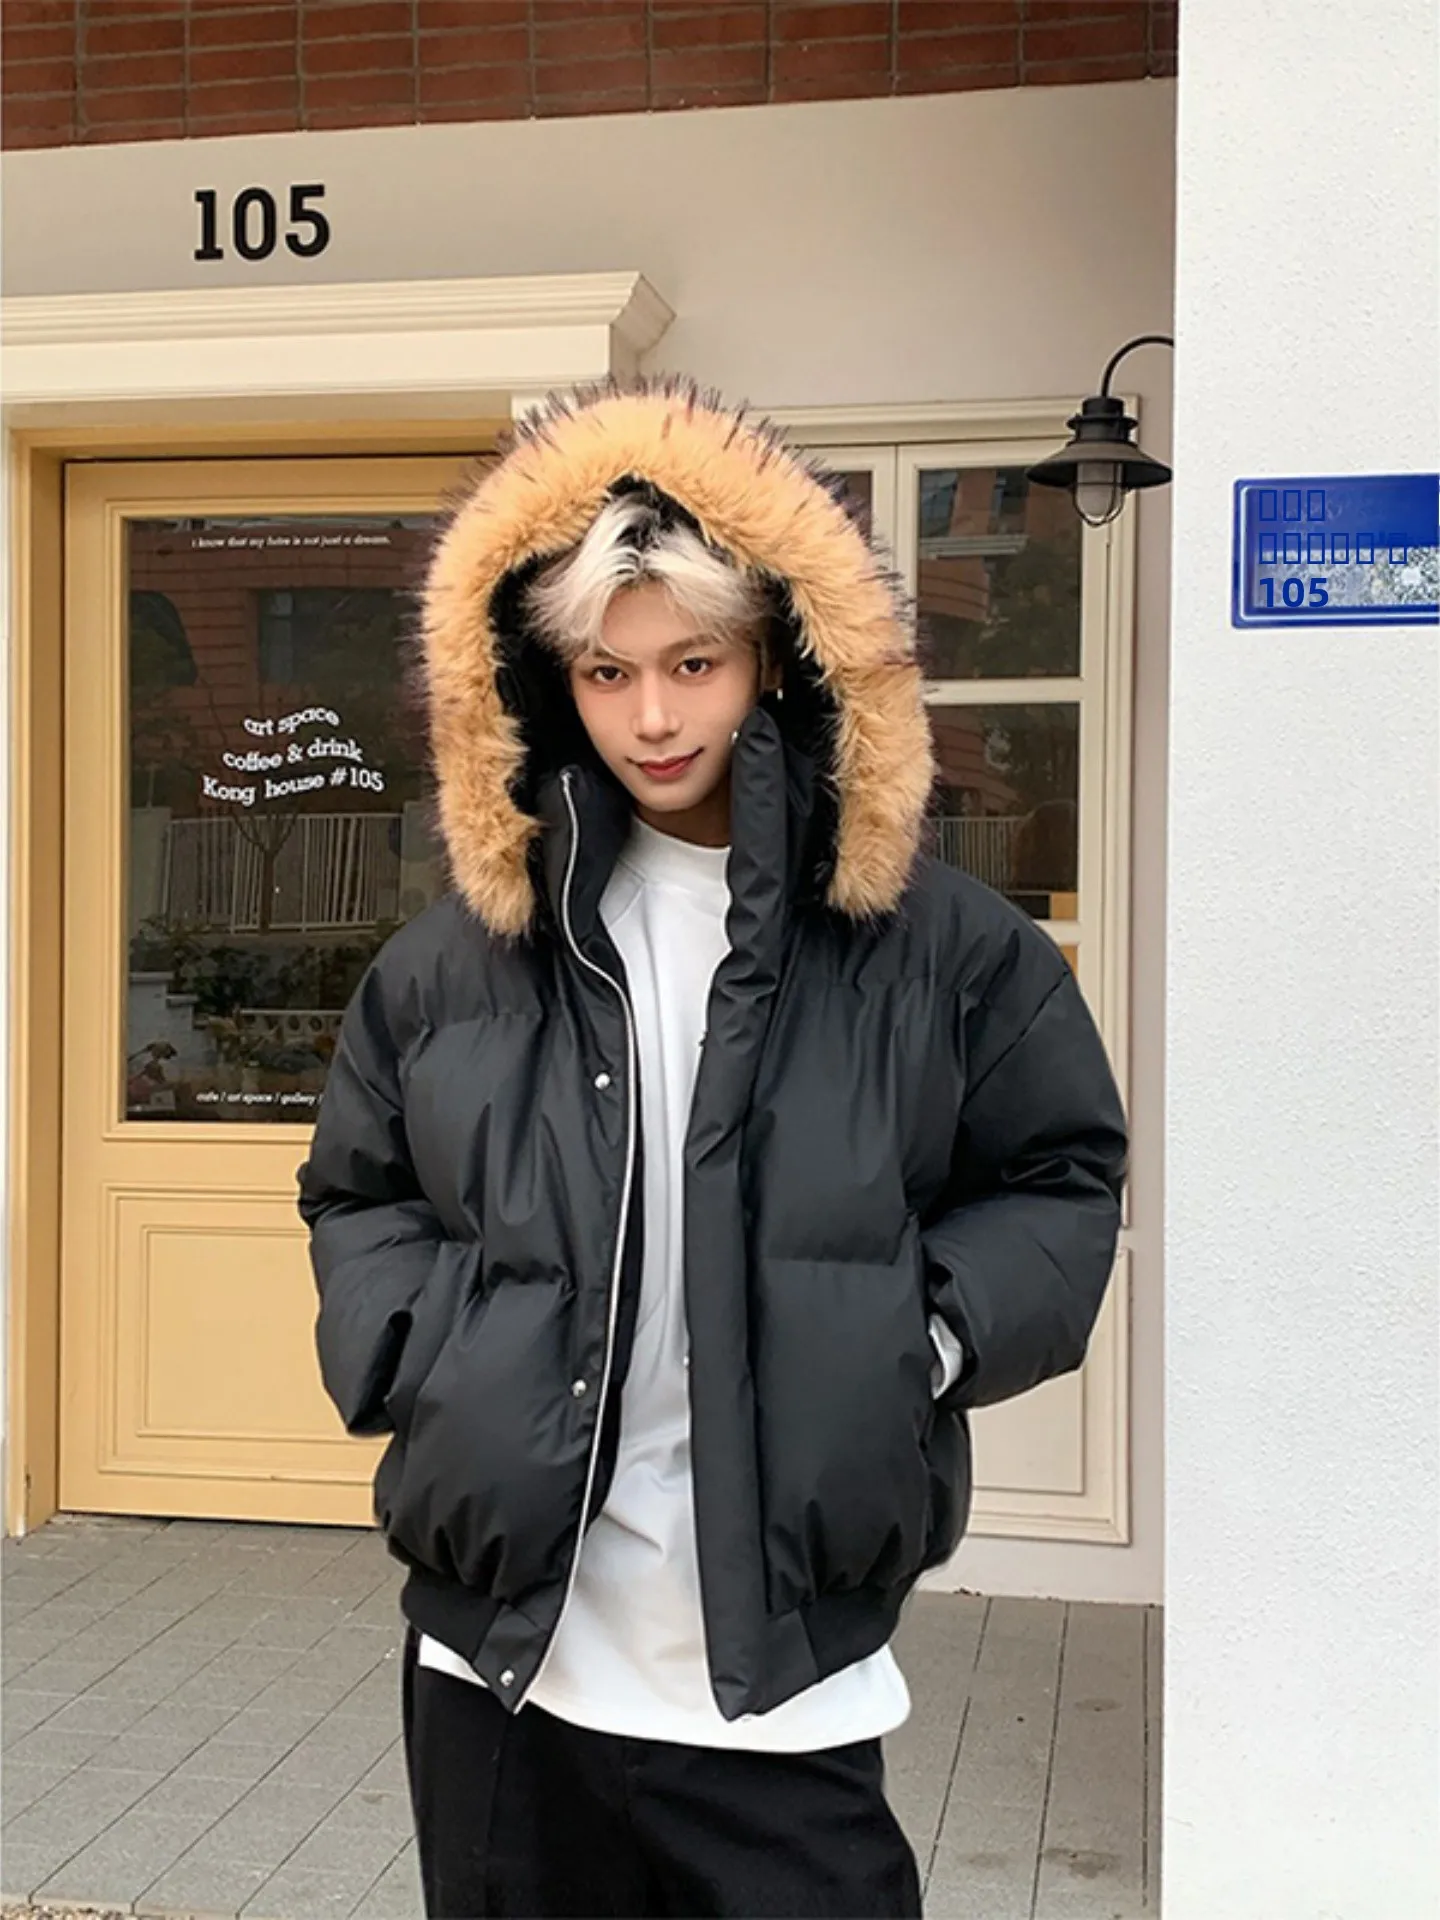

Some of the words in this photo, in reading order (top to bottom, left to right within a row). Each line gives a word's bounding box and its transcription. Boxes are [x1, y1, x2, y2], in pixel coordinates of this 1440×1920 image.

[194, 184, 330, 260] 105
[199, 536, 225, 547] know
[228, 536, 247, 547] that
[249, 538, 264, 549] my
[292, 536, 300, 546] is
[303, 536, 320, 545] not
[320, 535, 341, 547] just
[1259, 577, 1329, 608] 105
[244, 718, 274, 736] art
[278, 707, 340, 734] space
[223, 751, 283, 771] coffee
[287, 744, 303, 764] &
[307, 737, 363, 763] drink
[203, 775, 256, 806] Kong
[264, 774, 325, 798] house
[330, 767, 385, 792] #105
[227, 1092, 242, 1102] art
[242, 1092, 272, 1105] space
[281, 1091, 316, 1106] gallery
